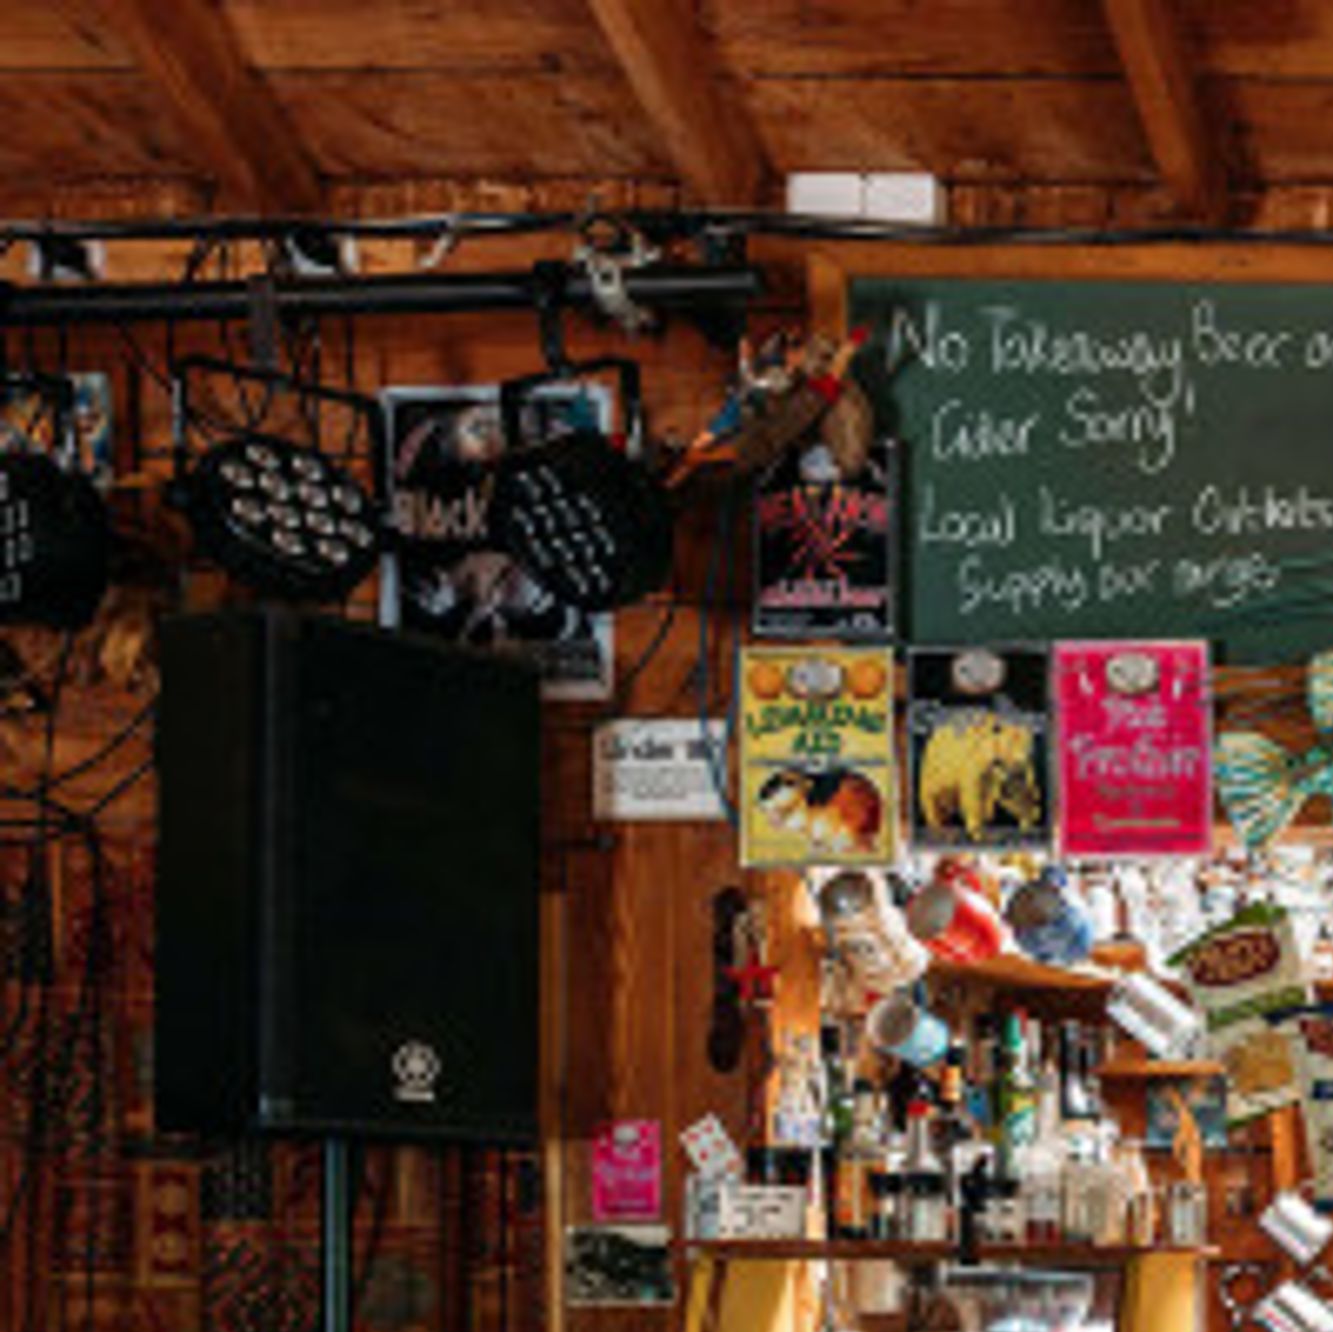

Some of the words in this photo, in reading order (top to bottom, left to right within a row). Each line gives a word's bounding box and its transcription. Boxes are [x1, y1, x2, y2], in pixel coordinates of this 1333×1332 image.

[885, 302, 968, 375] No
[1192, 299, 1292, 368] Beer
[919, 482, 1015, 547] Local
[1038, 484, 1171, 560] Liquor
